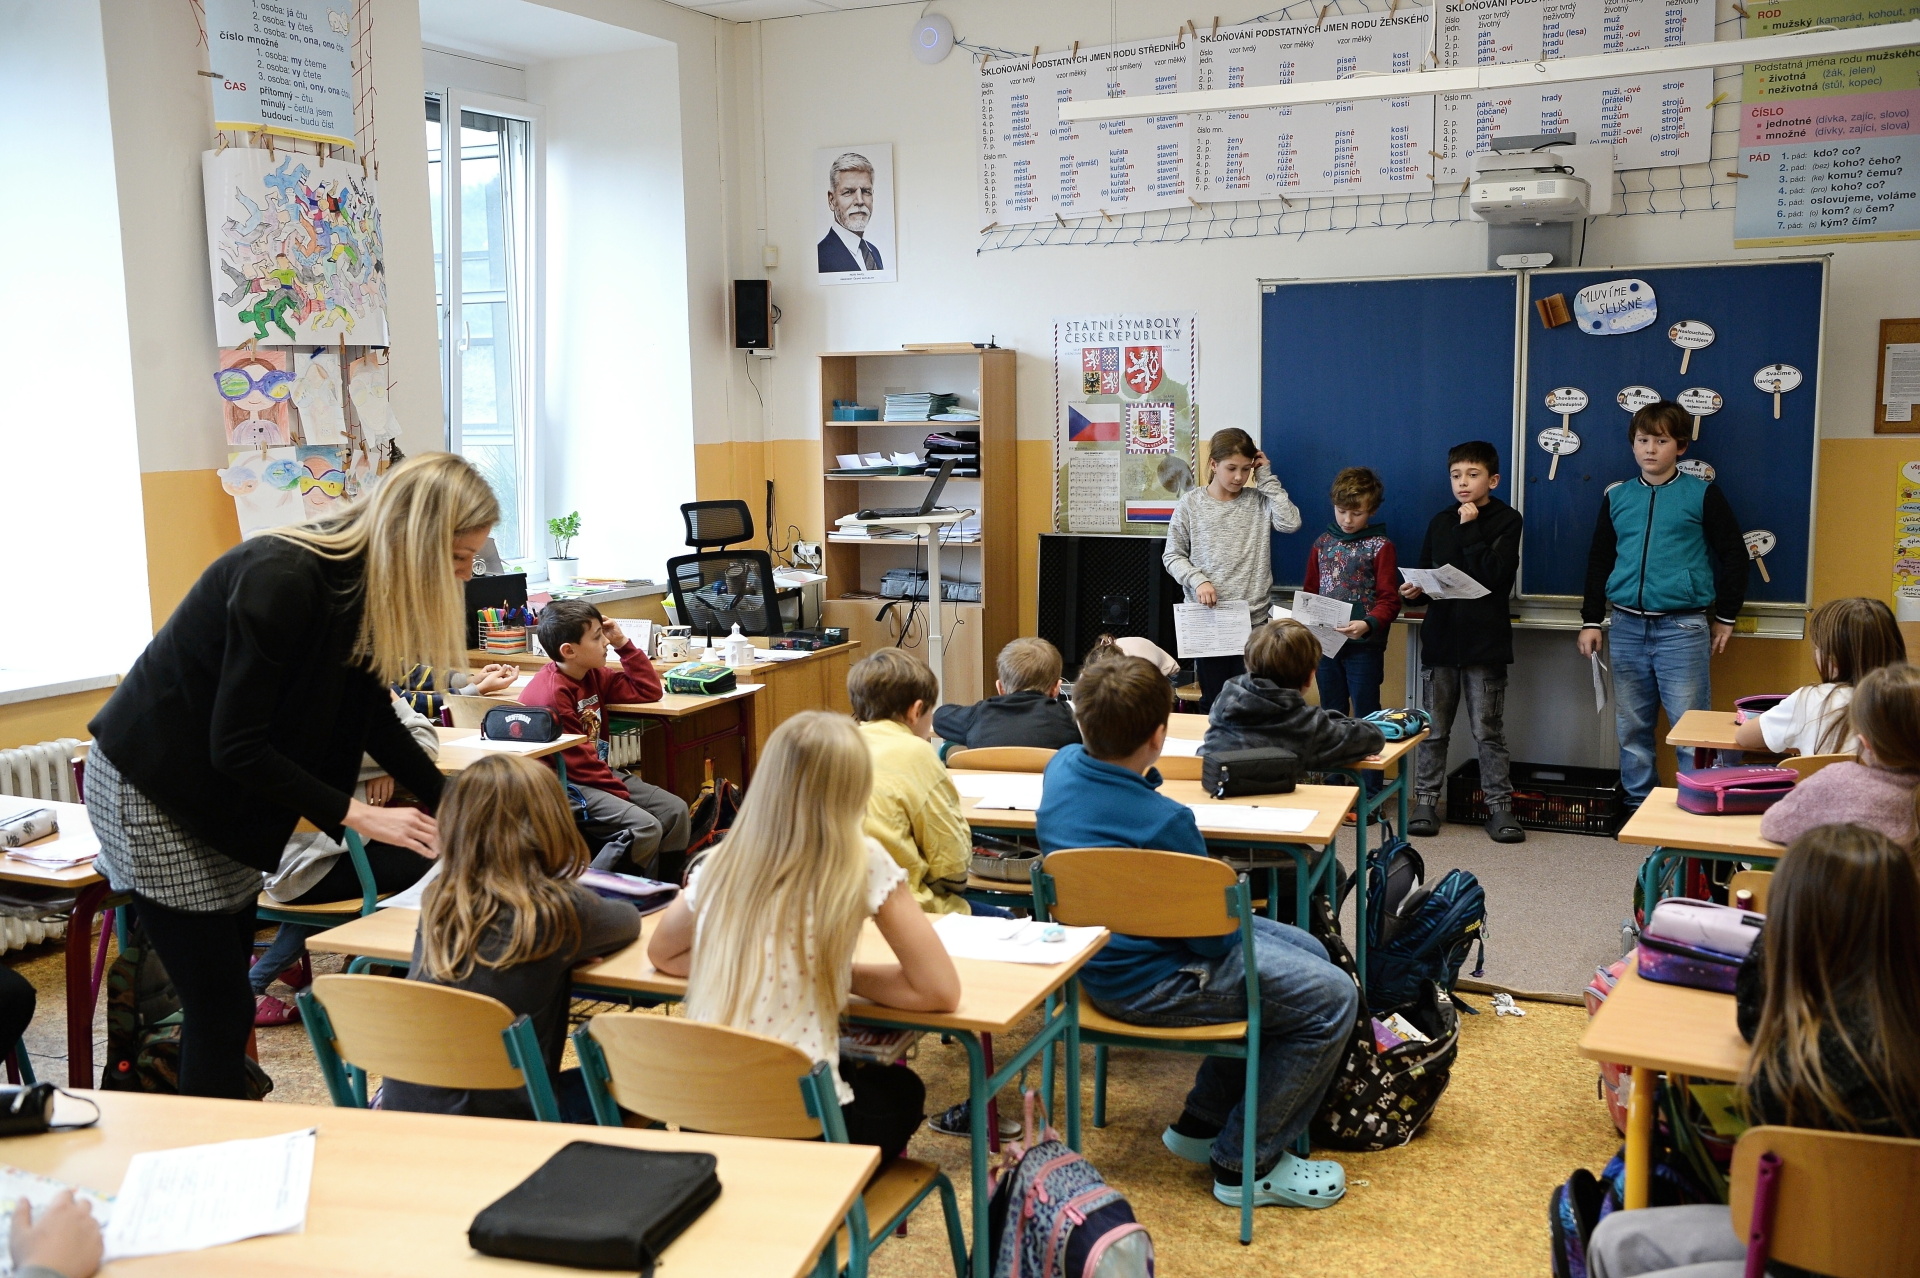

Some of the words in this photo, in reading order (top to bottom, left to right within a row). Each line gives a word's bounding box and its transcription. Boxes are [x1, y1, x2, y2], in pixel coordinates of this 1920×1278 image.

[261, 4, 285, 14] osoba:
[286, 8, 293, 17] já
[296, 11, 308, 20] čtu
[1604, 15, 1620, 24] muž
[1664, 16, 1687, 25] stroje
[1665, 8, 1683, 17] stroj
[1758, 9, 1781, 20] ROD
[1772, 18, 1813, 31] mužský
[1816, 12, 1865, 26] (kamarád,
[1868, 9, 1905, 20] kohout,
[253, 12, 260, 20] 2.
[263, 16, 285, 26] osoba:
[288, 20, 295, 30] ty
[297, 22, 313, 33] čteš
[1200, 30, 1254, 43] SKLOŇOVÁNÍ
[1255, 24, 1321, 38] PODSTATNÝCH
[1323, 23, 1349, 32] JMEN
[1351, 19, 1377, 30] RODU
[1379, 14, 1429, 26] ŽENSKÉHO
[1543, 22, 1560, 31] hrad
[1603, 24, 1624, 32] muže
[219, 31, 243, 41] číslo
[247, 37, 279, 48] množné
[254, 24, 261, 32] 3.
[264, 28, 287, 39] osoba:
[289, 33, 301, 43] on,
[304, 37, 320, 47] ona,
[1478, 31, 1491, 39] pán
[1542, 30, 1564, 39] hradu
[1566, 27, 1587, 37] (lesa)
[1477, 38, 1495, 47] pána
[265, 52, 288, 62] osoba:
[291, 57, 301, 67] my
[304, 57, 327, 69] čteme
[981, 62, 1030, 77] SKLOŇOVÁNÍ
[1090, 52, 1111, 63] JMEN
[1113, 49, 1137, 59] RODU
[1138, 41, 1186, 55] STŘEDNÍHO
[1392, 51, 1409, 59] kost
[1754, 59, 1803, 73] Podstatná
[1806, 58, 1836, 71] jména
[1839, 55, 1862, 65] rodu
[1866, 49, 1920, 62] mužského
[257, 60, 264, 68] 2.
[267, 64, 289, 74] osoba:
[292, 68, 301, 78] vy
[303, 70, 321, 80] čtete
[1769, 71, 1806, 83] životná
[1823, 67, 1846, 79] (žák,
[1849, 65, 1876, 78] jelen)
[224, 79, 247, 91] ČAS
[258, 72, 265, 80] 3.
[268, 76, 291, 86] osoba:
[293, 80, 308, 90] oni,
[310, 84, 326, 93] ony,
[1768, 82, 1818, 95] neživotná
[1848, 76, 1882, 89] kopec)
[260, 87, 293, 100] přítomný
[301, 92, 313, 103] čtu
[1541, 94, 1562, 103] hrady
[260, 99, 286, 111] minulý
[294, 103, 313, 115] četl/a
[315, 108, 333, 117] jsem
[1752, 107, 1784, 118] ČÍSLO
[262, 109, 293, 122] budoucí
[301, 117, 319, 127] budu
[321, 119, 334, 129] číst
[1766, 116, 1812, 130] jednotné
[1816, 114, 1847, 126] (dívka,
[1851, 111, 1876, 123] zajíc,
[1880, 108, 1909, 120] slovo)
[1765, 128, 1806, 140] množné
[1881, 121, 1910, 132] slova)
[1749, 153, 1770, 162] PÁD
[1792, 151, 1808, 161] pád:
[1814, 148, 1839, 158] kdo?
[1842, 146, 1861, 156] co?
[1779, 164, 1788, 172] 2.
[1791, 163, 1806, 172] pád:
[1813, 161, 1830, 170] (bez)
[1833, 158, 1864, 168] koho?
[1869, 155, 1901, 166] čeho?
[1389, 173, 1415, 181] kostmi
[1790, 174, 1806, 184] pád:
[1811, 174, 1825, 182] (ke)
[1828, 170, 1863, 181] komu?
[1867, 167, 1902, 178] čemu?
[1790, 186, 1805, 196] pád:
[1811, 185, 1828, 195] (pro)
[1831, 181, 1862, 192] koho?
[1866, 179, 1886, 190] co?
[1778, 198, 1786, 206] 5.
[1789, 197, 1804, 207] pád:
[1810, 193, 1874, 205] oslovujeme,
[1878, 190, 1916, 201] voláme
[1777, 210, 1786, 218] 6.
[1788, 209, 1803, 219] pád:
[1810, 209, 1818, 218] (o)
[1822, 205, 1850, 216] kom?
[1853, 206, 1862, 215] (o)
[1866, 203, 1894, 213] čem?
[1778, 221, 1786, 230] 7.
[1788, 220, 1803, 230] pád:
[1820, 217, 1848, 228] kým?
[1852, 216, 1877, 226] čím?
[1579, 286, 1627, 304] MLUVÍME
[1598, 296, 1642, 314] SLUŠNĚ
[1066, 318, 1113, 333] STÁTNÍ
[1118, 317, 1181, 330] SYMBOLY
[1065, 330, 1104, 343] ČESKÉ
[1109, 329, 1181, 341] REPUBLIKY
